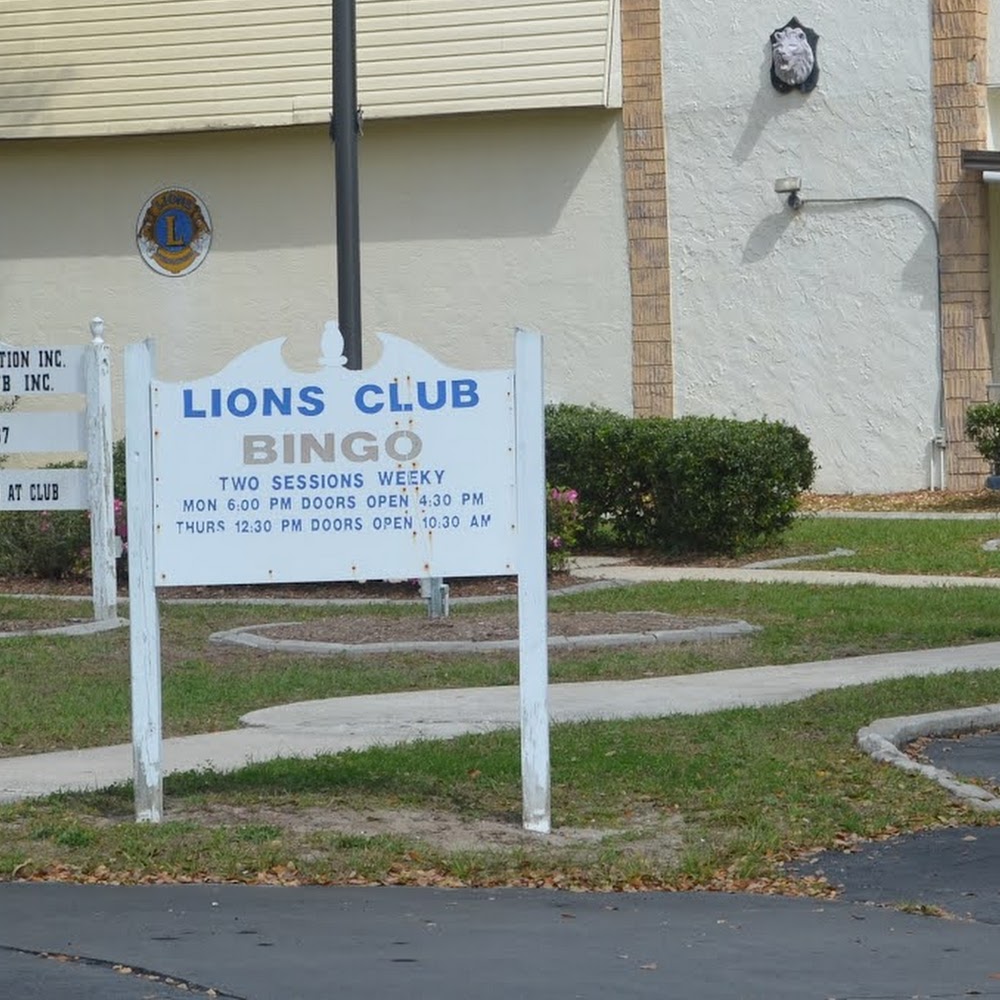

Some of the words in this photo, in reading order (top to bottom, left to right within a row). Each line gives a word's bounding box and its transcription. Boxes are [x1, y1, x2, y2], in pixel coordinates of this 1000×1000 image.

[166, 215, 185, 247] L
[39, 350, 66, 368] INC.
[0, 375, 11, 392] B
[25, 374, 54, 391] INC.
[183, 386, 325, 418] LIONS
[354, 379, 480, 414] CLUB
[243, 430, 423, 465] BINGO
[219, 476, 259, 491] TWO
[272, 473, 364, 490] SESSIONS
[378, 470, 445, 486] WEEKY
[8, 484, 22, 501] AT
[30, 483, 59, 501] CLUB
[183, 499, 217, 512] MON
[227, 498, 260, 511] 6:00
[270, 497, 292, 510] PM
[302, 496, 356, 510] DOORS
[366, 495, 409, 508] OPEN
[419, 494, 452, 507] 4:30
[462, 492, 484, 506] PM
[176, 520, 225, 534] THURS
[235, 519, 272, 533] 12:30
[281, 518, 302, 532] PM
[311, 517, 363, 532] DOORS
[372, 516, 413, 530] OPEN
[422, 515, 460, 529] 10:30
[470, 514, 491, 528] AM
